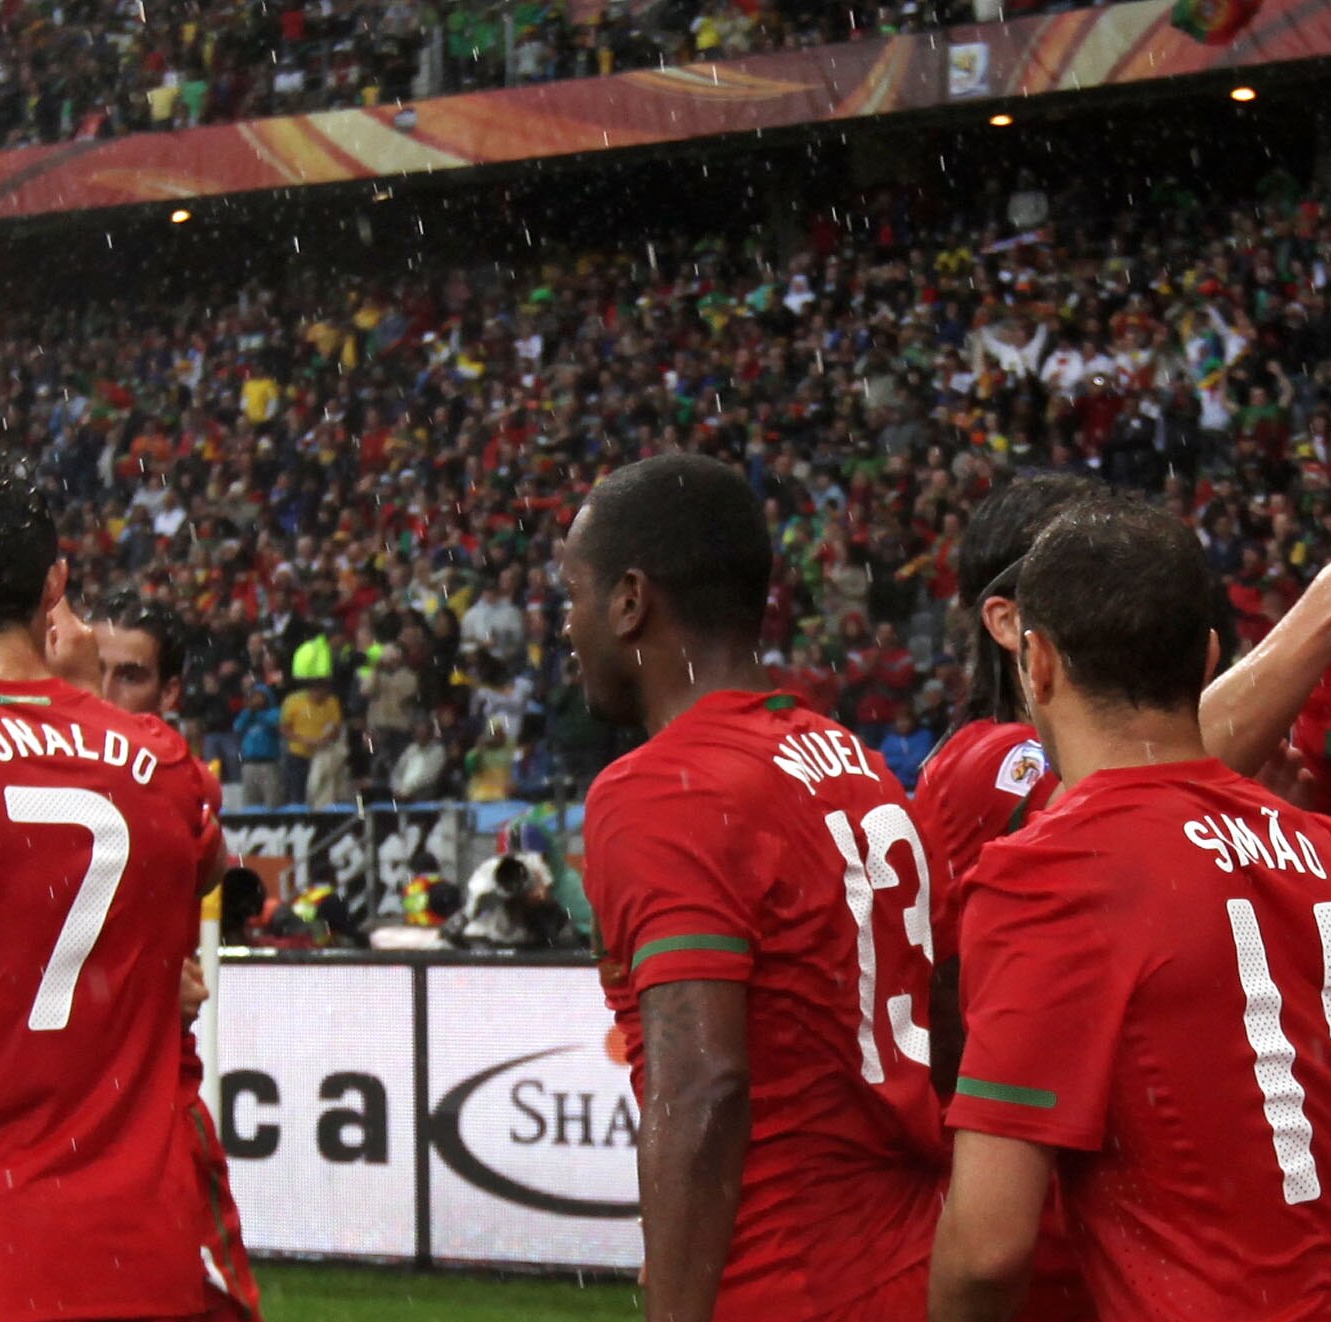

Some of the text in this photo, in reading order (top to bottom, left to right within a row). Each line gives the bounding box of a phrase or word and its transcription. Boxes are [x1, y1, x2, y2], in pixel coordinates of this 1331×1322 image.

[3, 786, 130, 1031] 7
[1183, 806, 1328, 880] SIMÃO
[824, 803, 934, 1084] 13
[219, 1067, 390, 1164] ca
